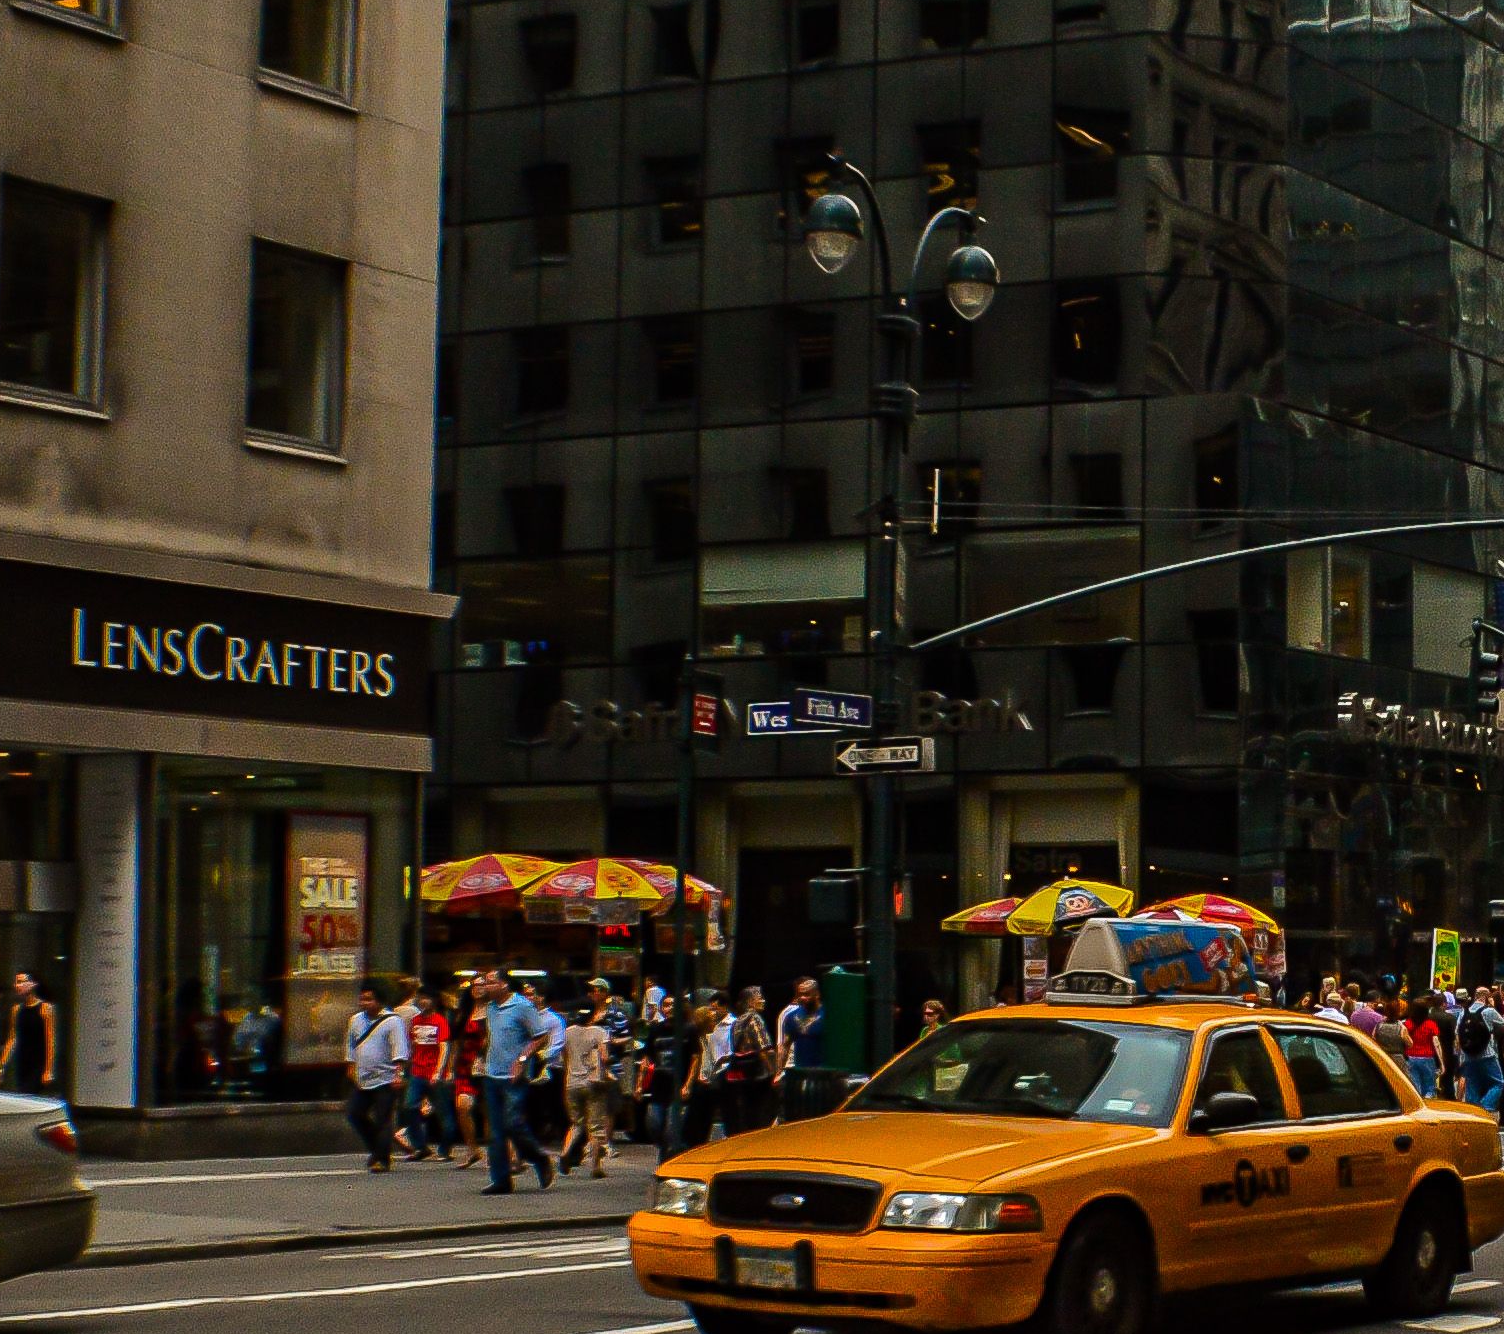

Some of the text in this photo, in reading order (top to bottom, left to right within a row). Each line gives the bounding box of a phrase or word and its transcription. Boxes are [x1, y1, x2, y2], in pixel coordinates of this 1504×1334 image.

[752, 710, 789, 728] Wes
[807, 697, 860, 720] Fifth Ave
[299, 876, 359, 908] SALE
